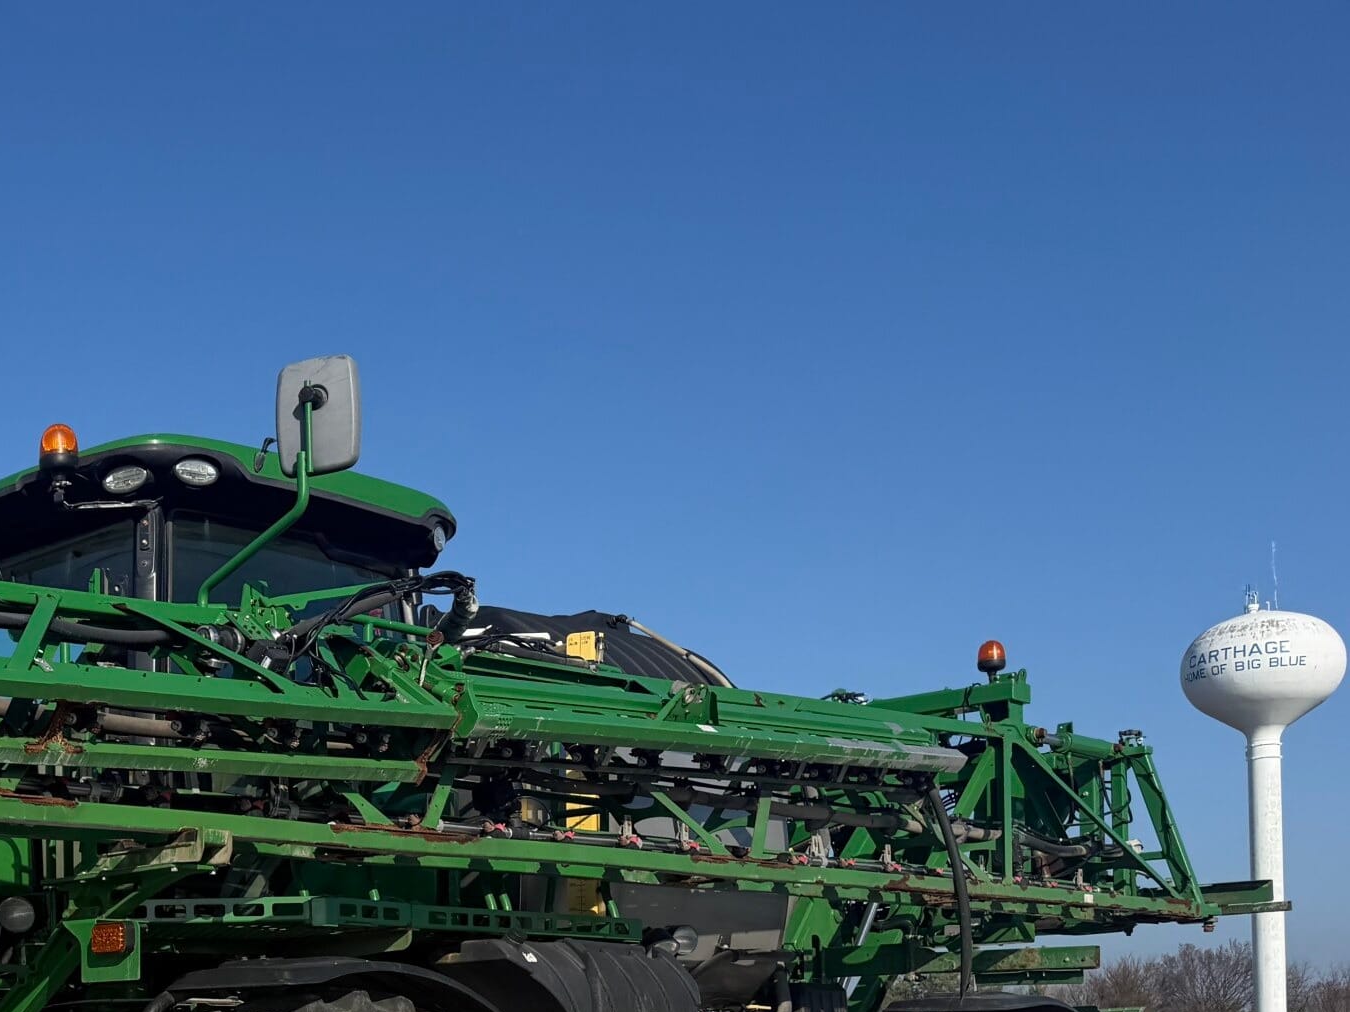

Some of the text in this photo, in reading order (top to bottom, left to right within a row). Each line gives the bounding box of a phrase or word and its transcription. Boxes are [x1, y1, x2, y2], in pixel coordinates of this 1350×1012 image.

[1188, 640, 1290, 669] CARTHAGE
[1212, 664, 1227, 676] OF
[1235, 659, 1261, 672] BIG
[1269, 656, 1306, 668] BLUE
